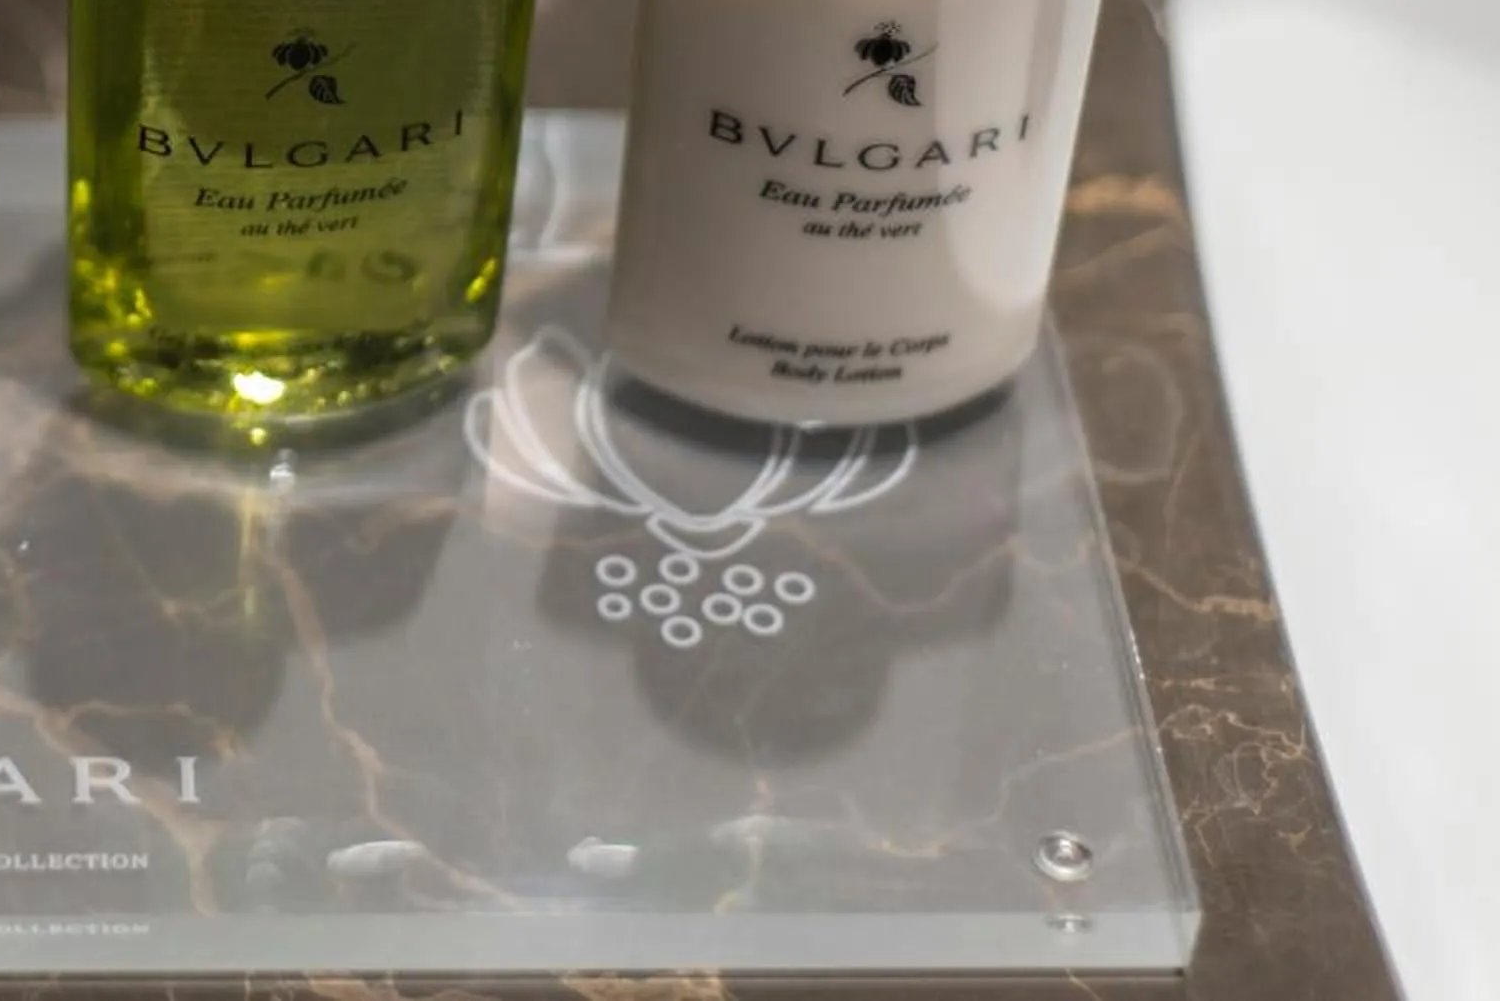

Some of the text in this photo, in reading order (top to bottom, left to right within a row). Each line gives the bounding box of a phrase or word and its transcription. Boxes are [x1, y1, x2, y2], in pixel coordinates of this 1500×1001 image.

[137, 109, 463, 168] BVLGARI
[708, 108, 1030, 170] BVLGARI
[193, 177, 409, 212] Eau Parfumée
[759, 179, 972, 217] Eau Parfumée
[240, 215, 358, 237] au thé vert
[803, 218, 923, 238] au thé vert
